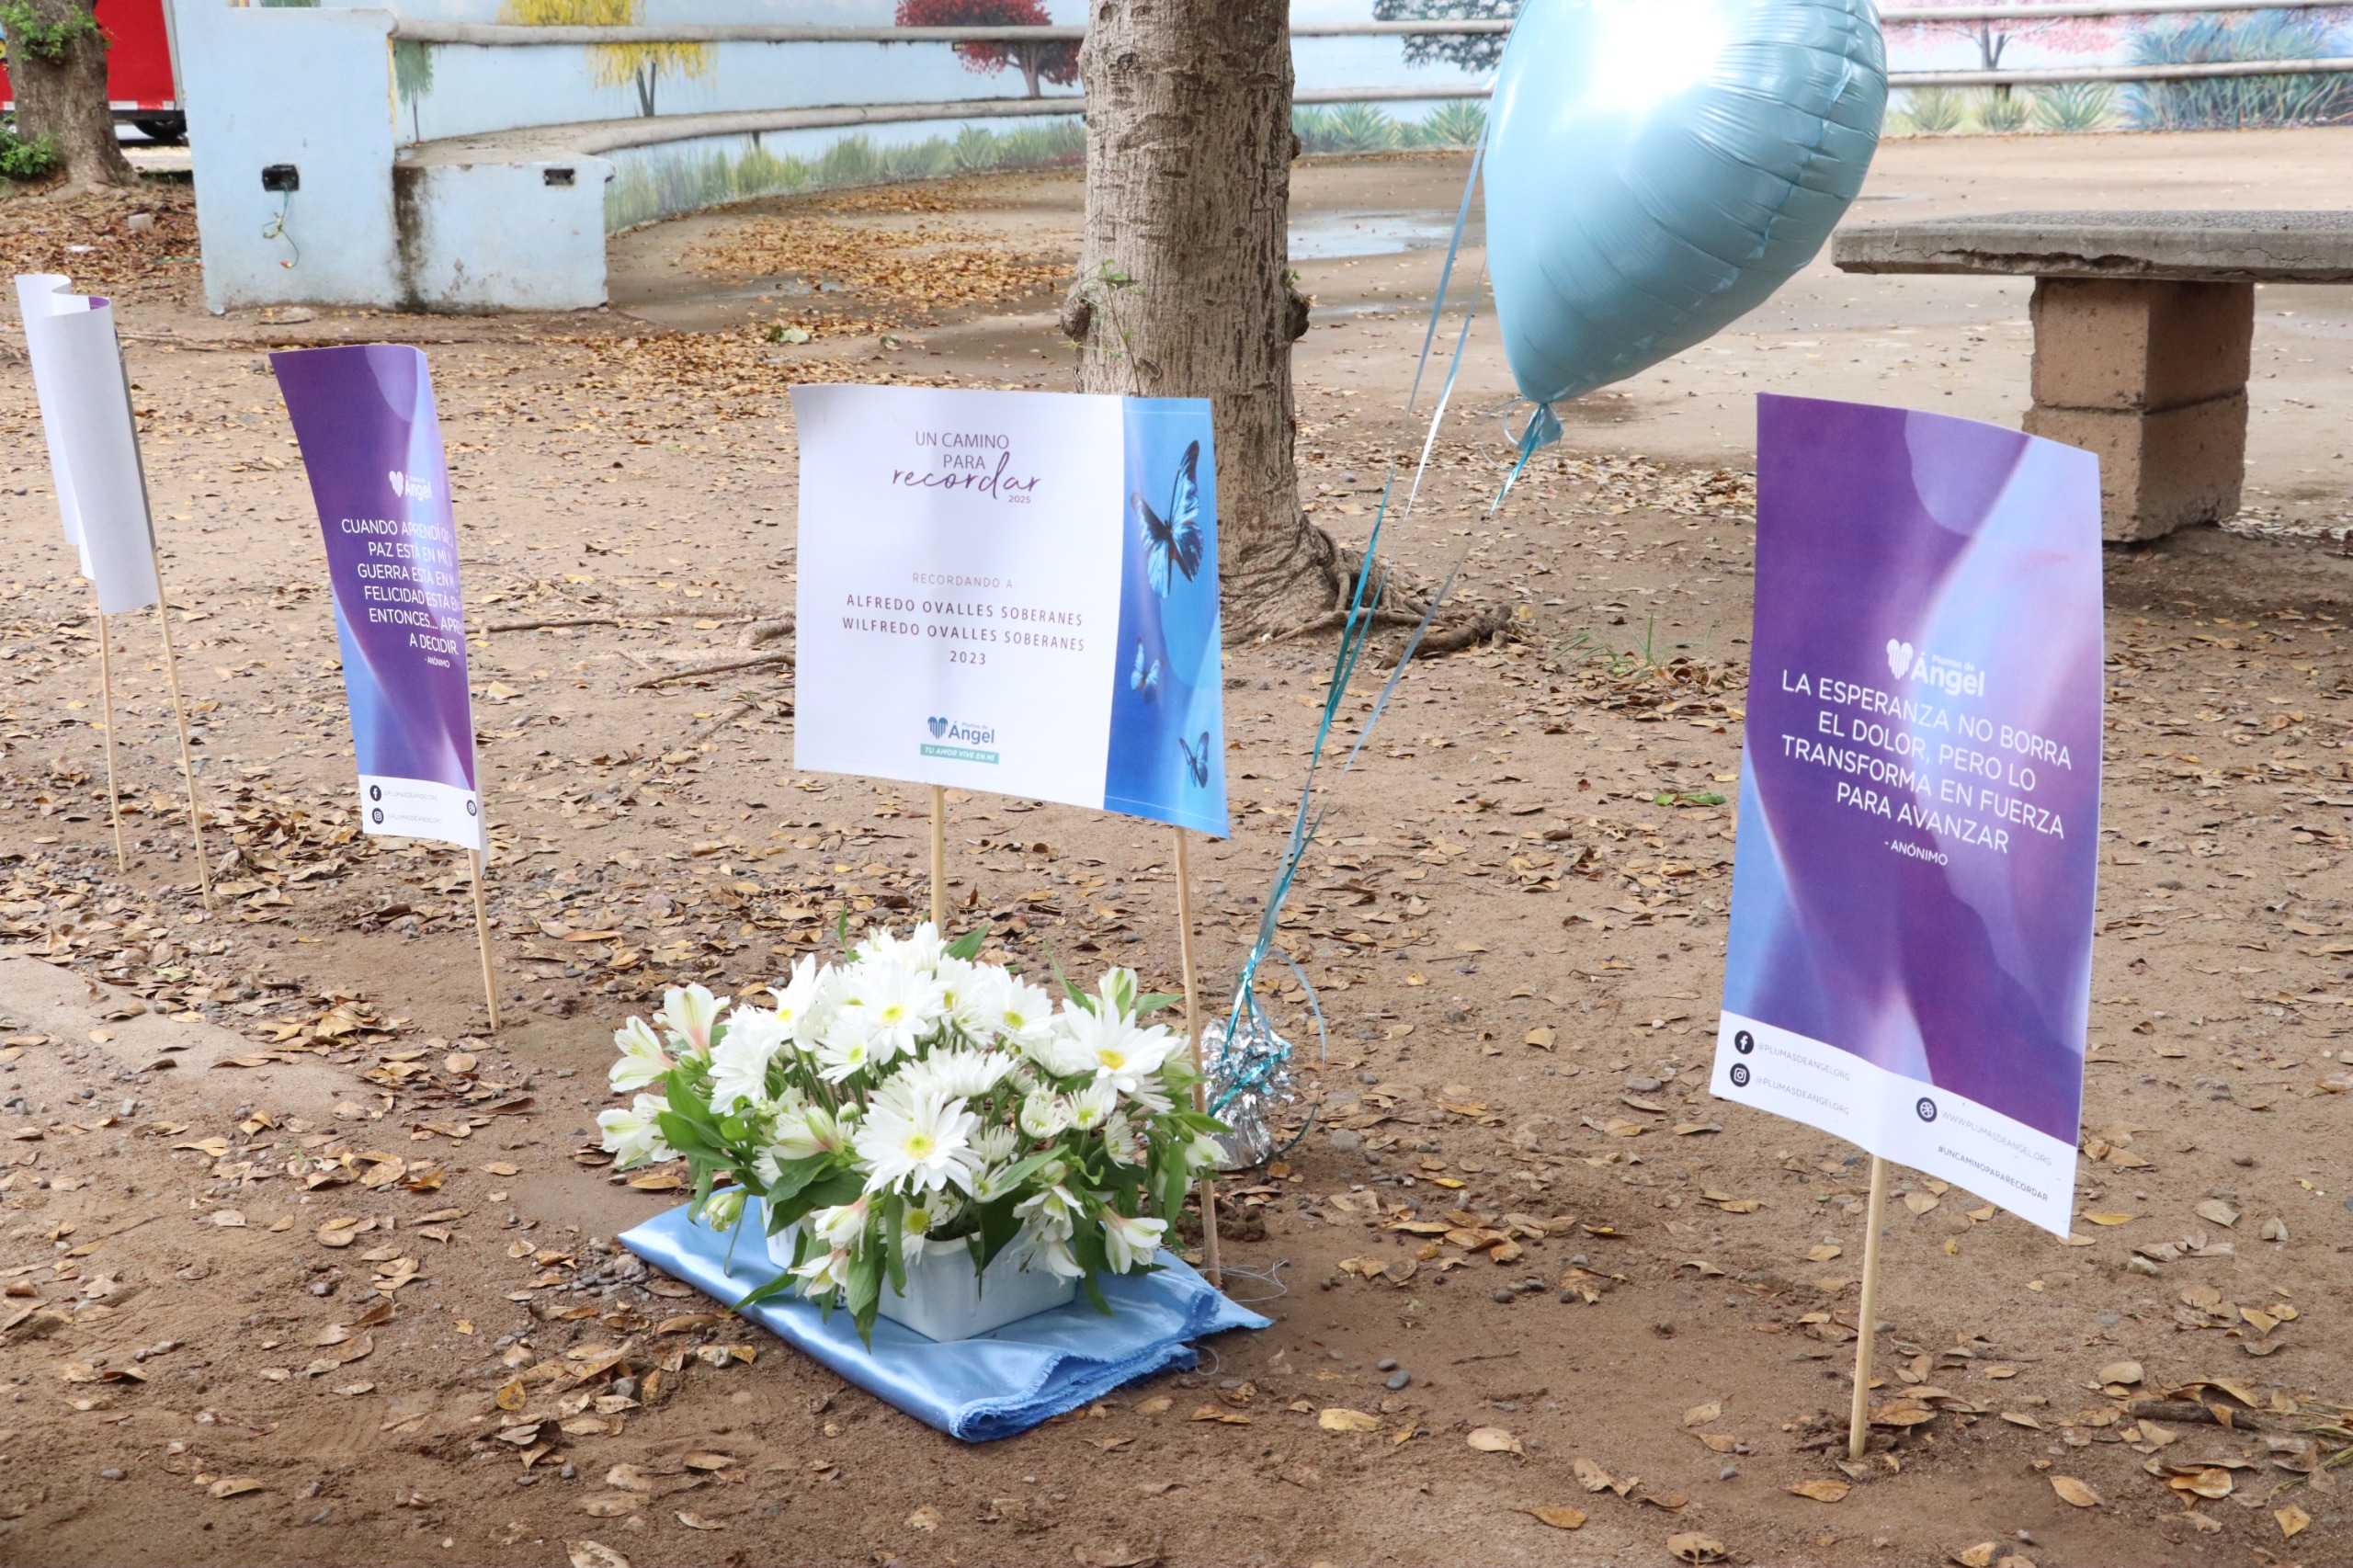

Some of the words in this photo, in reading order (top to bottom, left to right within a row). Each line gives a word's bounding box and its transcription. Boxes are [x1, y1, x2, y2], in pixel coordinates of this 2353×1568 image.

[915, 431, 938, 447] UN
[941, 432, 1009, 449] CAMINO
[943, 454, 986, 470] PARA
[404, 474, 432, 501] Ángel
[892, 450, 1041, 500] recordar
[1007, 494, 1031, 504] 2025
[341, 518, 398, 536] CUANDO
[402, 521, 441, 541] APRENDÍ
[369, 541, 393, 557] PAZ
[396, 541, 421, 560] ESTÁ
[422, 547, 436, 563] EN
[358, 562, 410, 581] GUERRA
[411, 566, 434, 585] ESTÁ
[435, 571, 449, 587] EN
[913, 573, 1000, 588] RECORDANDO
[364, 585, 425, 605] FELICIDAD
[426, 591, 450, 609] ESTÁ
[847, 594, 915, 611] ALFREDO
[922, 600, 994, 618] OVALLES
[1001, 606, 1083, 627] SOBERANES
[409, 632, 418, 648] A
[418, 633, 460, 655] DECIDIR.
[843, 617, 919, 635] WILFREDO
[926, 625, 996, 642] OVALLES
[1005, 631, 1085, 652] SOBERANES
[949, 650, 986, 665] 2023
[1931, 653, 1962, 669] Plumas
[1963, 662, 1975, 672] de
[1910, 650, 1985, 698] Ángel
[961, 722, 981, 730] Plumas
[1781, 669, 1812, 697] LA
[1819, 676, 1950, 733] ESPERANZA
[1958, 713, 1994, 743] NO
[2000, 724, 2073, 770] BORRA
[948, 721, 995, 745] Ángel
[936, 747, 958, 756] AMOR
[959, 750, 974, 759] VIVE
[975, 753, 986, 761] EN
[1818, 710, 1845, 738] EL
[1852, 718, 1930, 766] DOLOR,
[1938, 743, 2002, 780] PERO
[2007, 762, 2037, 791] LO
[1781, 733, 1932, 798] TRANSFORMA
[1939, 778, 1972, 808] EN
[1980, 789, 2065, 840] FUERZA
[1836, 781, 1892, 820] PARA
[1897, 801, 2009, 854] AVANZAR
[1890, 840, 1949, 866] ANÓNIMO
[1757, 1042, 1850, 1082] @PLUMASDEANGELORG
[1756, 1076, 1849, 1116] @PLUMASDEANGELORG
[1938, 1145, 2049, 1201] #UNCAMINOPARARECORDAR
